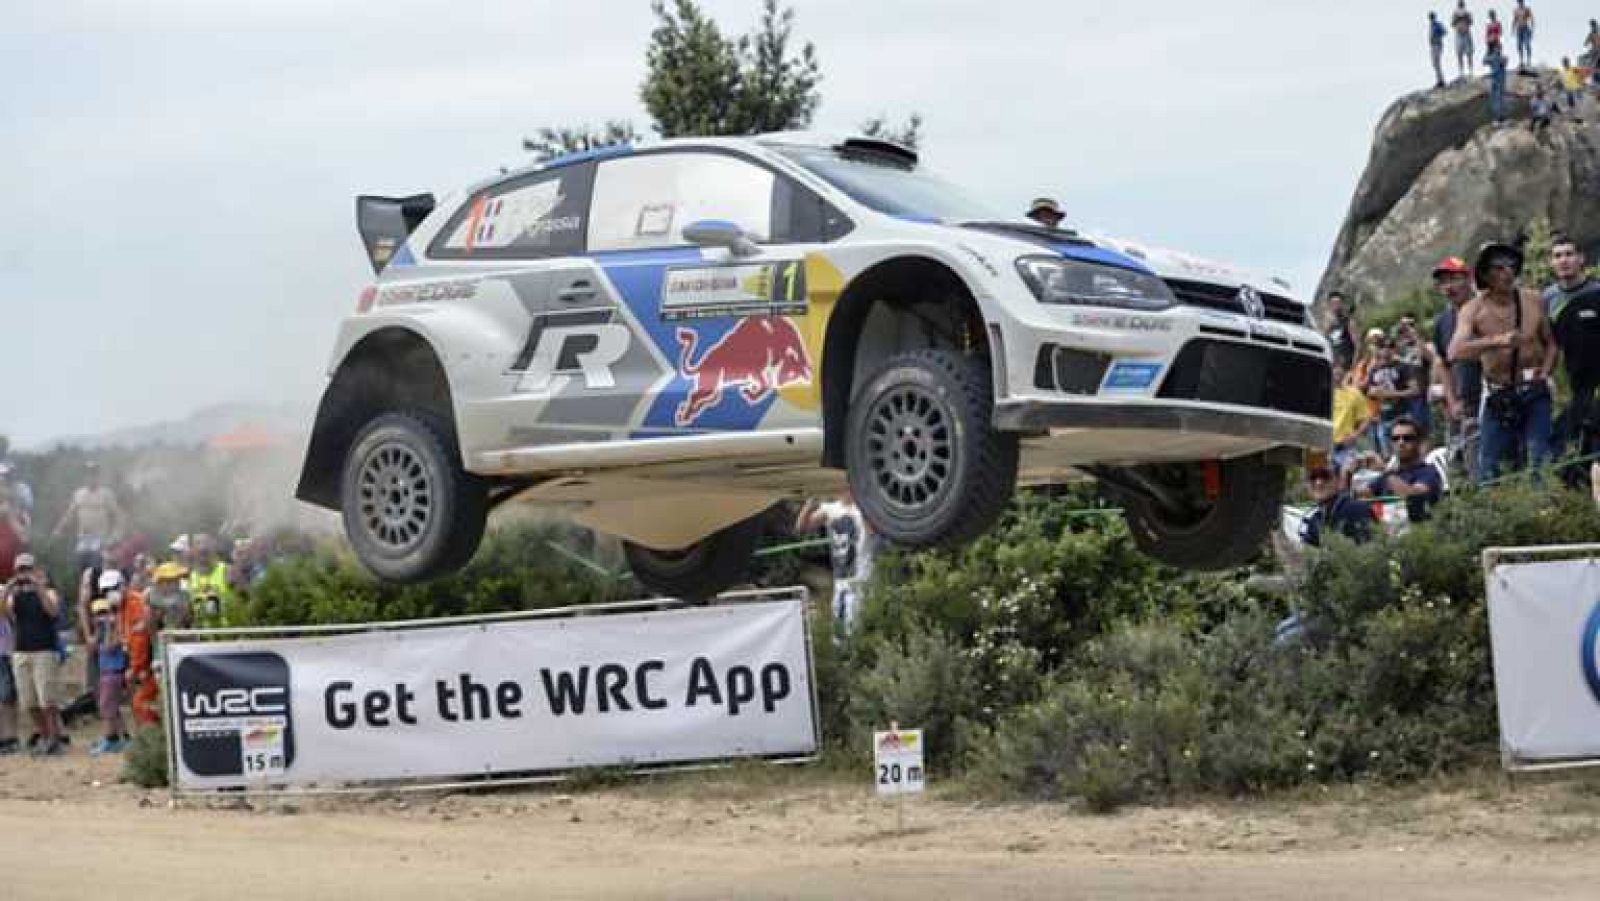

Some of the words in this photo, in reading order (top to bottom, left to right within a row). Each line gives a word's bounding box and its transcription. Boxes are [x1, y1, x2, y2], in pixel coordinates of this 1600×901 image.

[782, 262, 798, 301] 1
[182, 687, 286, 715] WRC
[324, 682, 418, 730] Get
[437, 674, 523, 723] the
[540, 661, 669, 717] WRC
[686, 656, 792, 716] App
[246, 753, 266, 772] 15
[879, 763, 902, 784] 20
